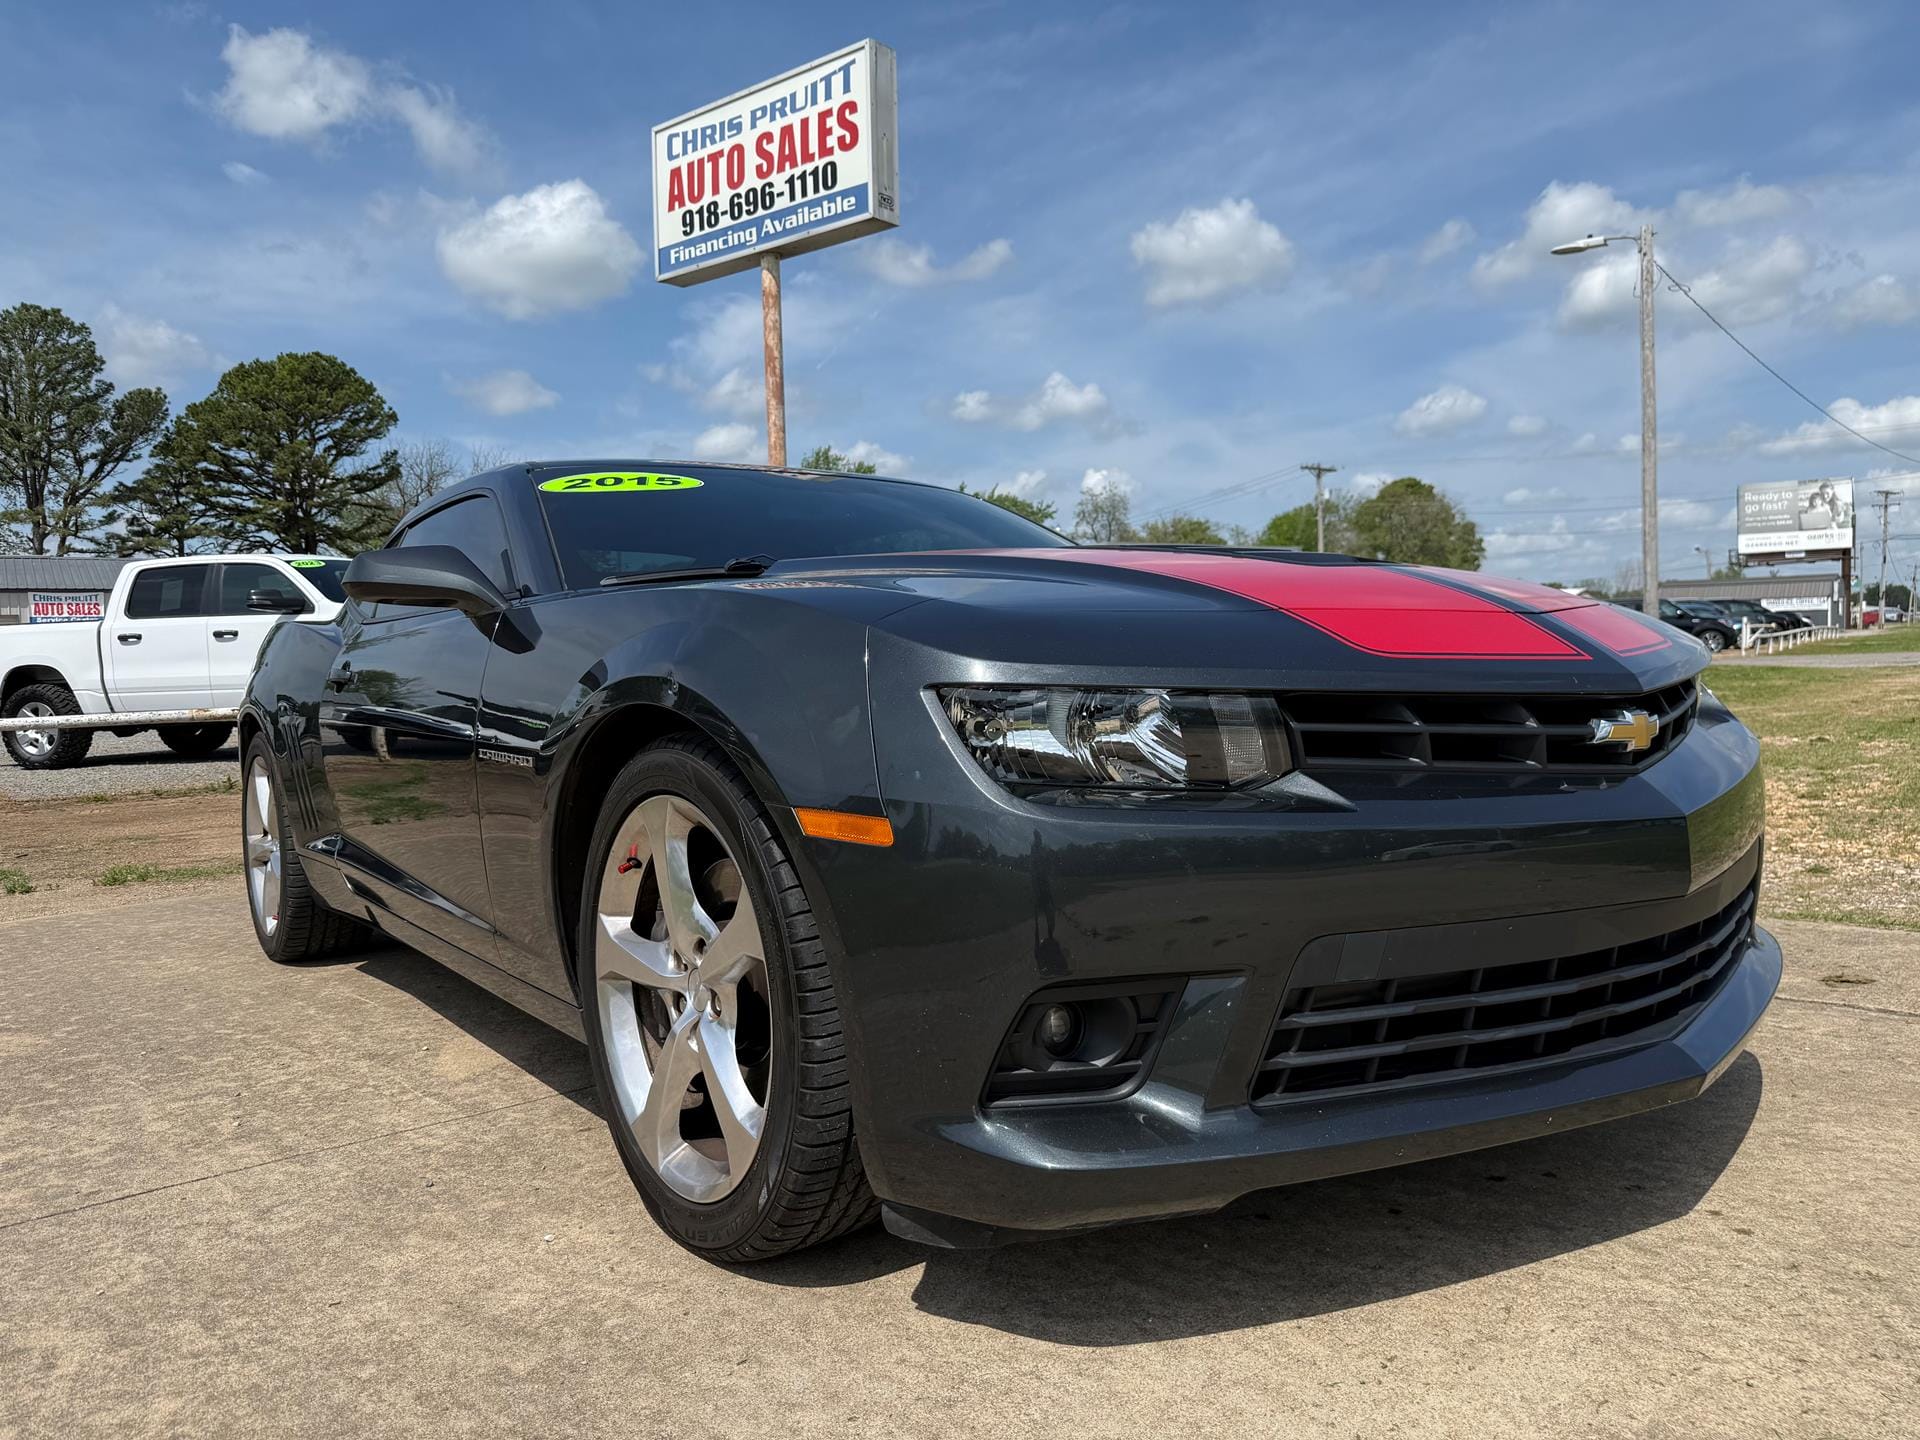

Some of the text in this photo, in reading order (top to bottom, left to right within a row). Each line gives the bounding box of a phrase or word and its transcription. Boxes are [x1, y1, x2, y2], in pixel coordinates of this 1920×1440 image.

[667, 58, 856, 161] CHRIS PRUITT
[668, 100, 859, 213] AUTO SALES
[682, 161, 838, 237] 918-696-1110
[670, 226, 757, 265] Financing
[762, 195, 856, 236] Available
[562, 476, 682, 490] 2015
[1745, 490, 1793, 502] Ready to
[1745, 500, 1788, 514] go fast?
[32, 593, 100, 602] CHRIS PRUITT
[33, 602, 101, 616] AUTO SALES
